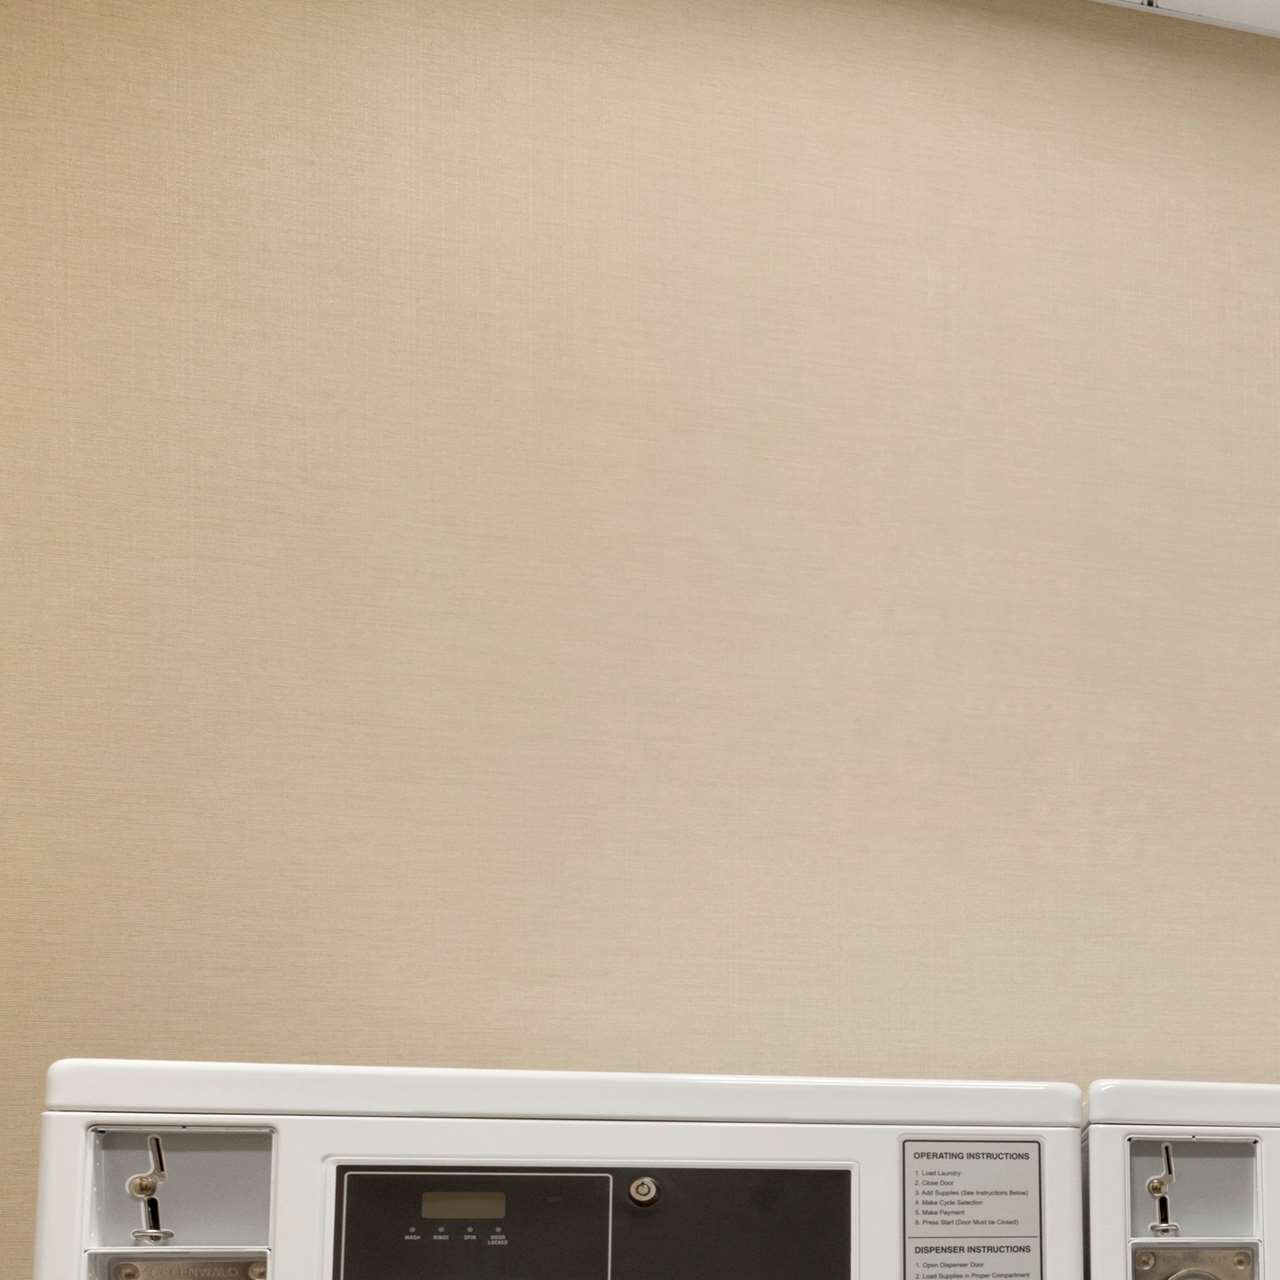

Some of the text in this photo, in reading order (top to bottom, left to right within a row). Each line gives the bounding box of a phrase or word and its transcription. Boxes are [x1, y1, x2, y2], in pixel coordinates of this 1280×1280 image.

[914, 1152, 1030, 1160] OPERATING INSTRUCTIONS
[914, 1245, 1031, 1254] DISPENSER INSTRUCTIONS
